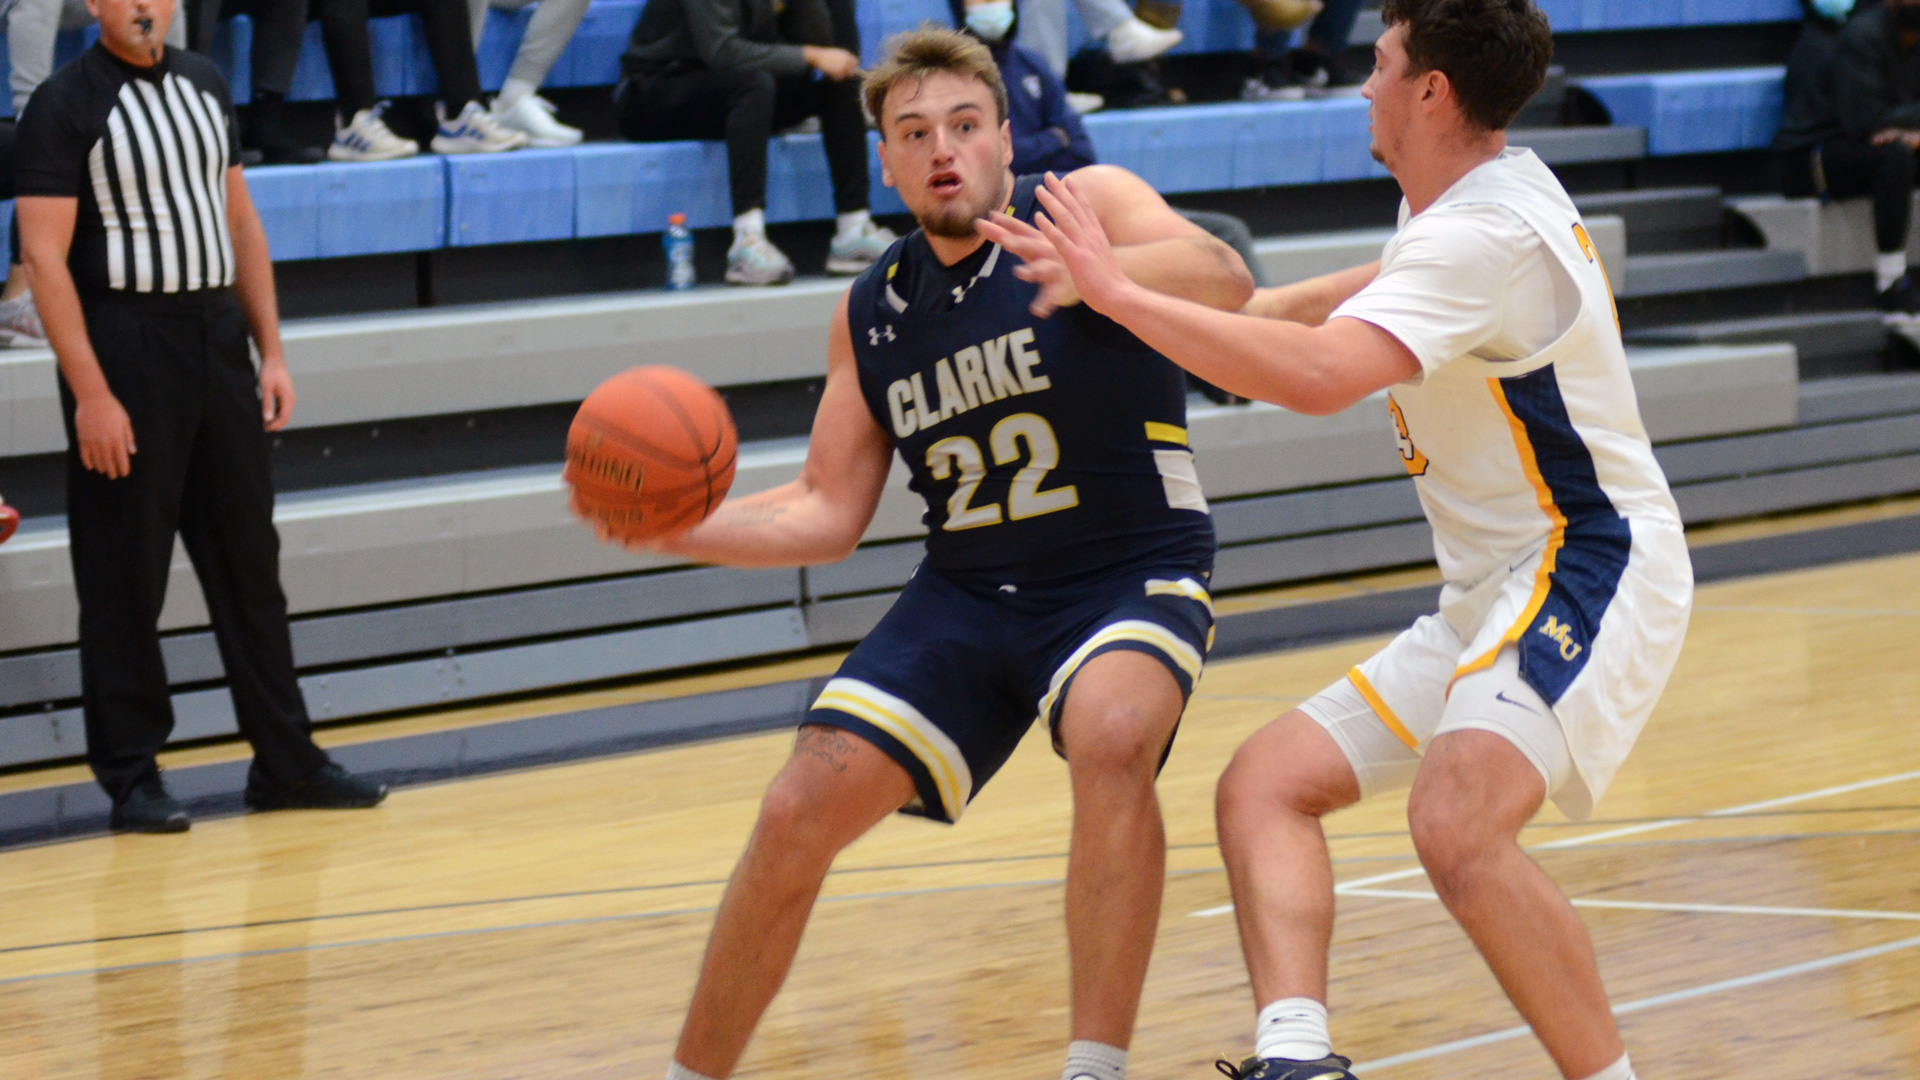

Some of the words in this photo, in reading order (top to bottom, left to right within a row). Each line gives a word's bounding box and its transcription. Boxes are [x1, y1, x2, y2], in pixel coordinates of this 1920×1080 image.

[887, 327, 1051, 438] CLARKE
[925, 412, 1079, 531] 22
[1538, 615, 1582, 662] MU
